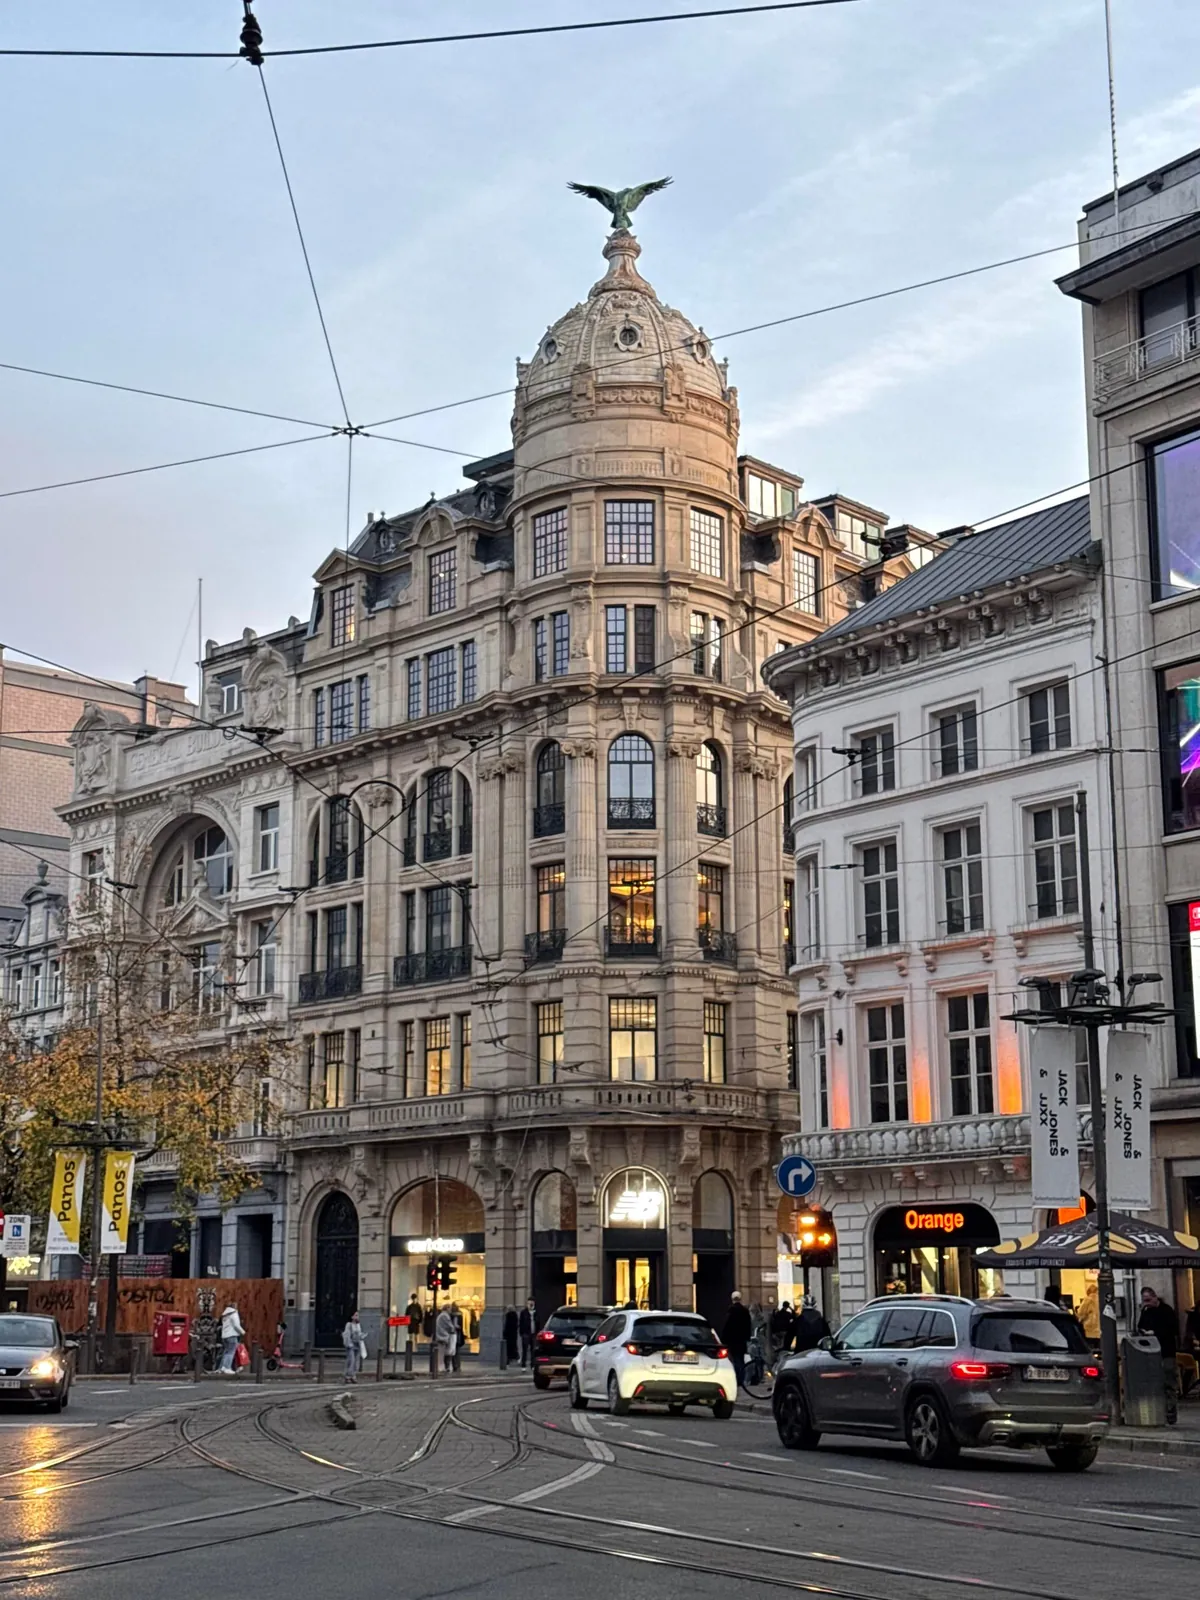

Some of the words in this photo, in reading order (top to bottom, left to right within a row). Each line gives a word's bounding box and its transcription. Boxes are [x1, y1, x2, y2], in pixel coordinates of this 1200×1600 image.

[1039, 1068, 1048, 1078] &
[1058, 1070, 1068, 1107] JACK
[1114, 1073, 1123, 1082] &
[1133, 1074, 1142, 1110] JACK
[1039, 1093, 1048, 1126] JJXX
[1114, 1096, 1122, 1129] JJXX
[1049, 1110, 1058, 1156] JONES
[1123, 1113, 1132, 1159] JONES
[1060, 1147, 1069, 1156] &
[1133, 1150, 1142, 1159] &
[57, 1160, 76, 1222] Panos
[109, 1170, 126, 1232] Panos
[905, 1209, 964, 1232] Orange
